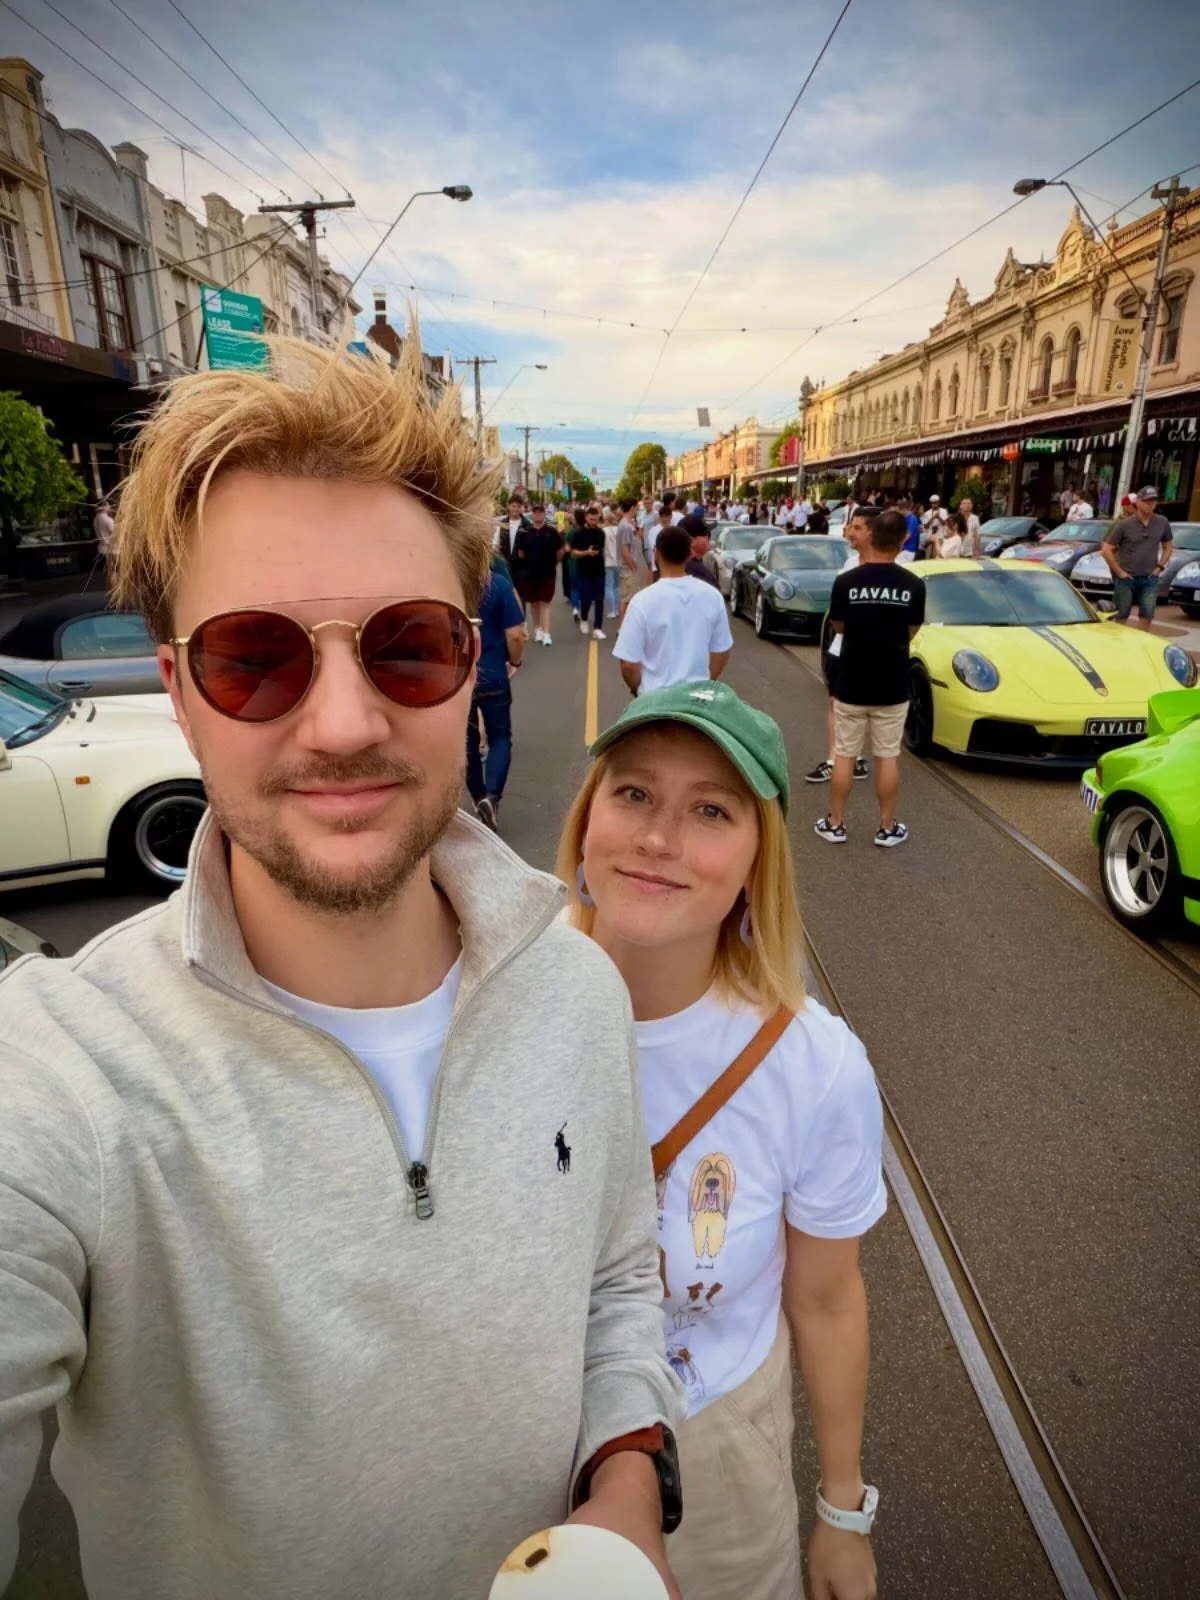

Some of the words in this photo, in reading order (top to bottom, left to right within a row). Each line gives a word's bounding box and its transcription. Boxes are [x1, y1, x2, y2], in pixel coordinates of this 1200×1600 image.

[1115, 325, 1135, 335] Love
[1119, 338, 1131, 369] South
[1104, 338, 1121, 393] Melbourne
[848, 587, 911, 602] CAVALO
[1090, 721, 1142, 735] CAVALO
